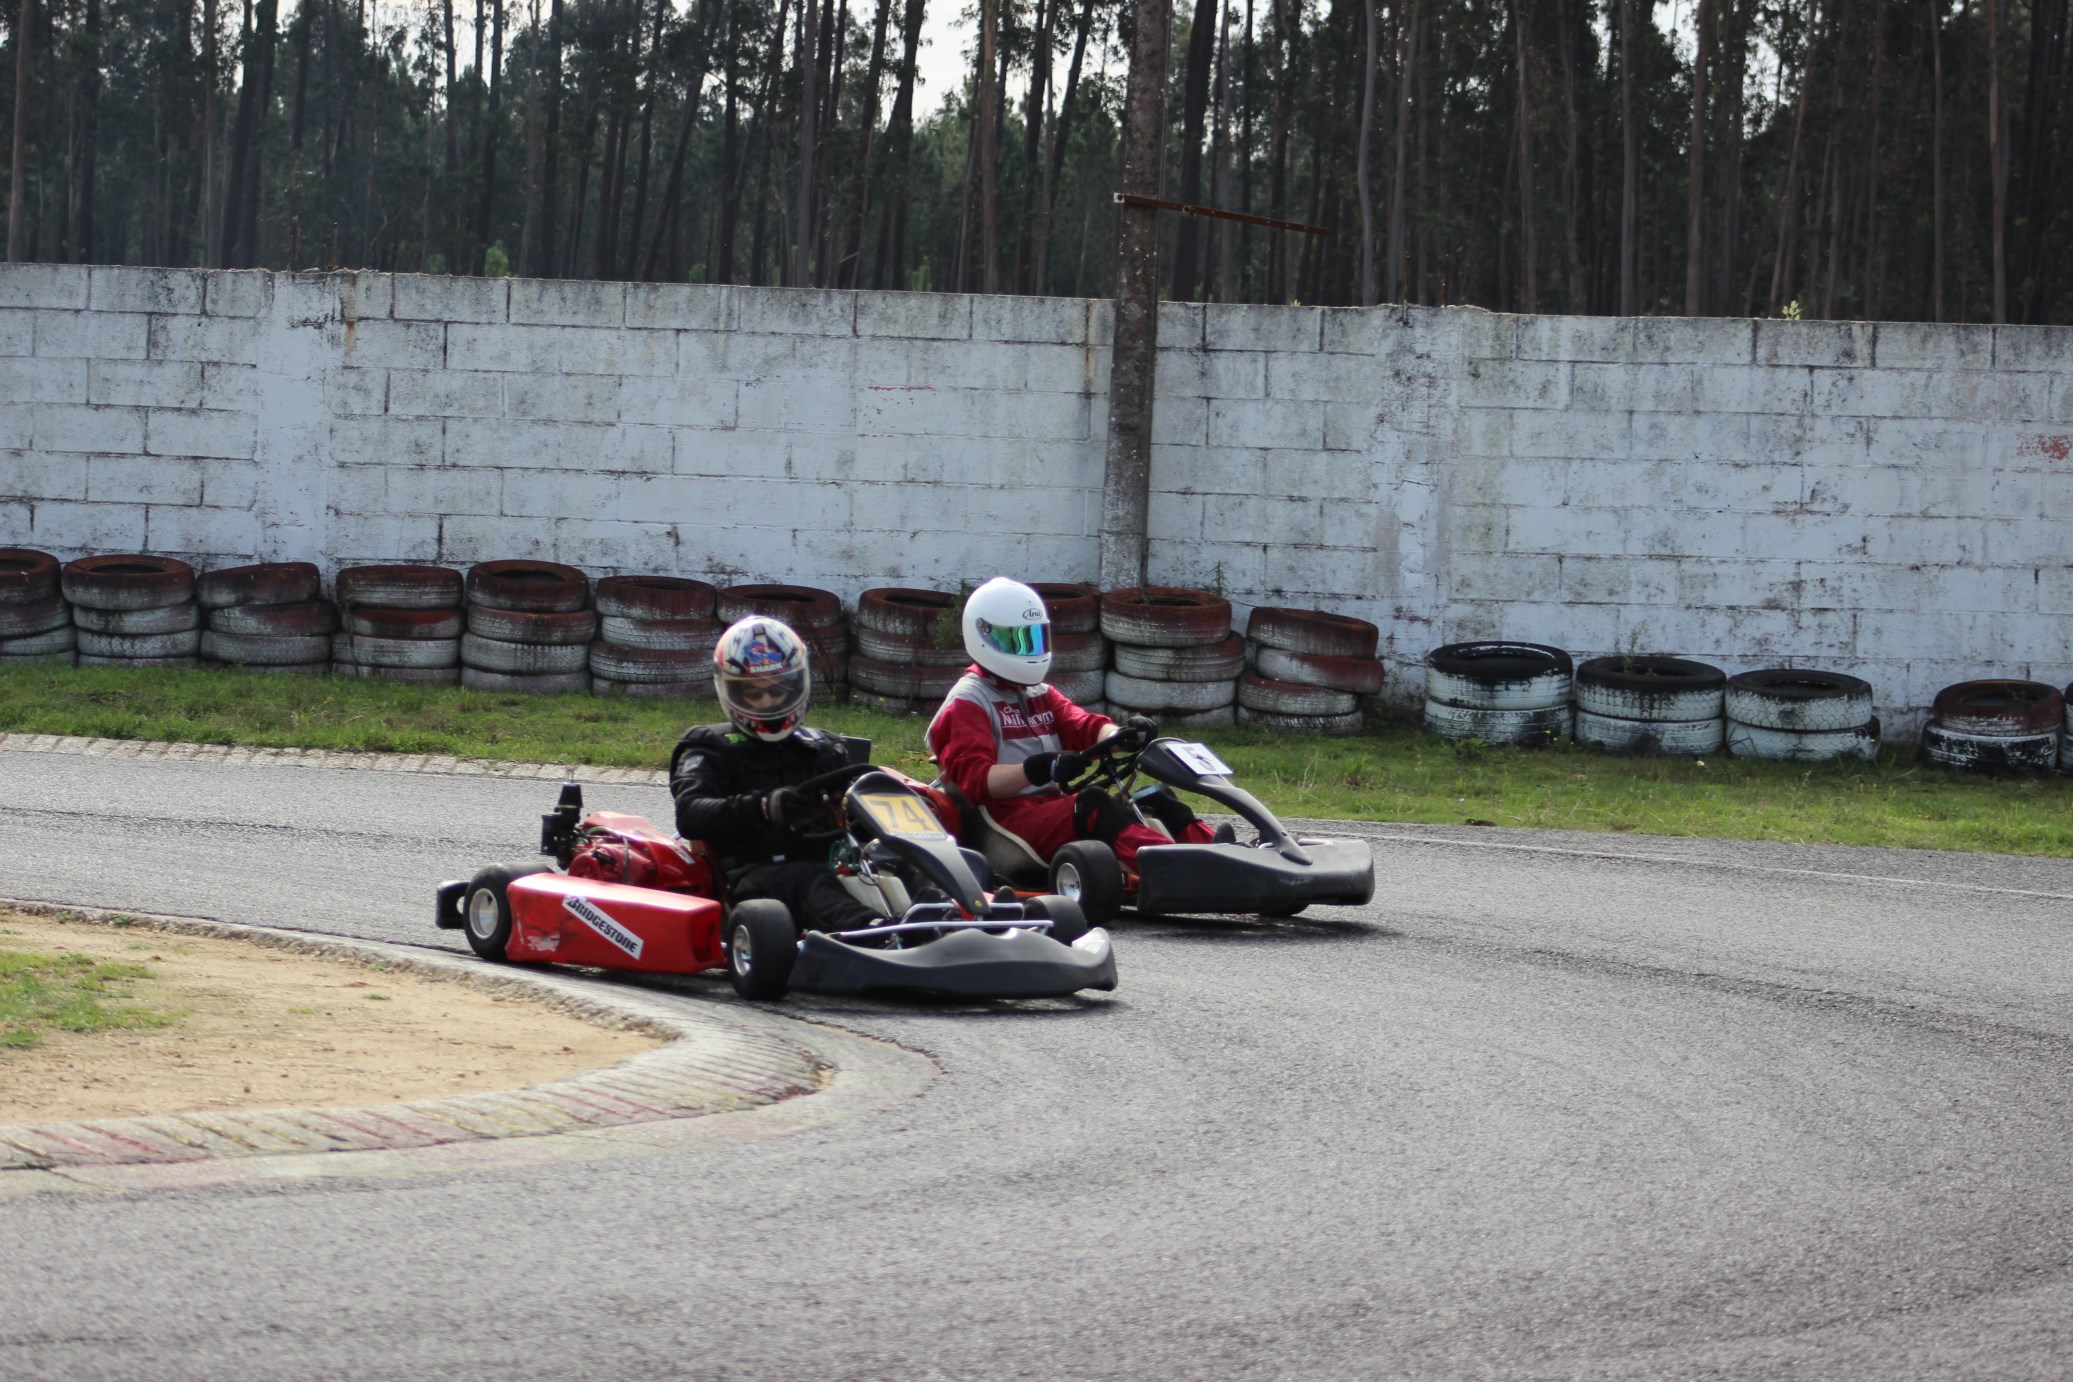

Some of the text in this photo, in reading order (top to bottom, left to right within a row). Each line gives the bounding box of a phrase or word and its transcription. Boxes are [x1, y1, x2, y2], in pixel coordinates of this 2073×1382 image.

[750, 662, 782, 673] SHARK
[870, 800, 933, 831] 74
[566, 898, 637, 953] BRIDGESTONE
